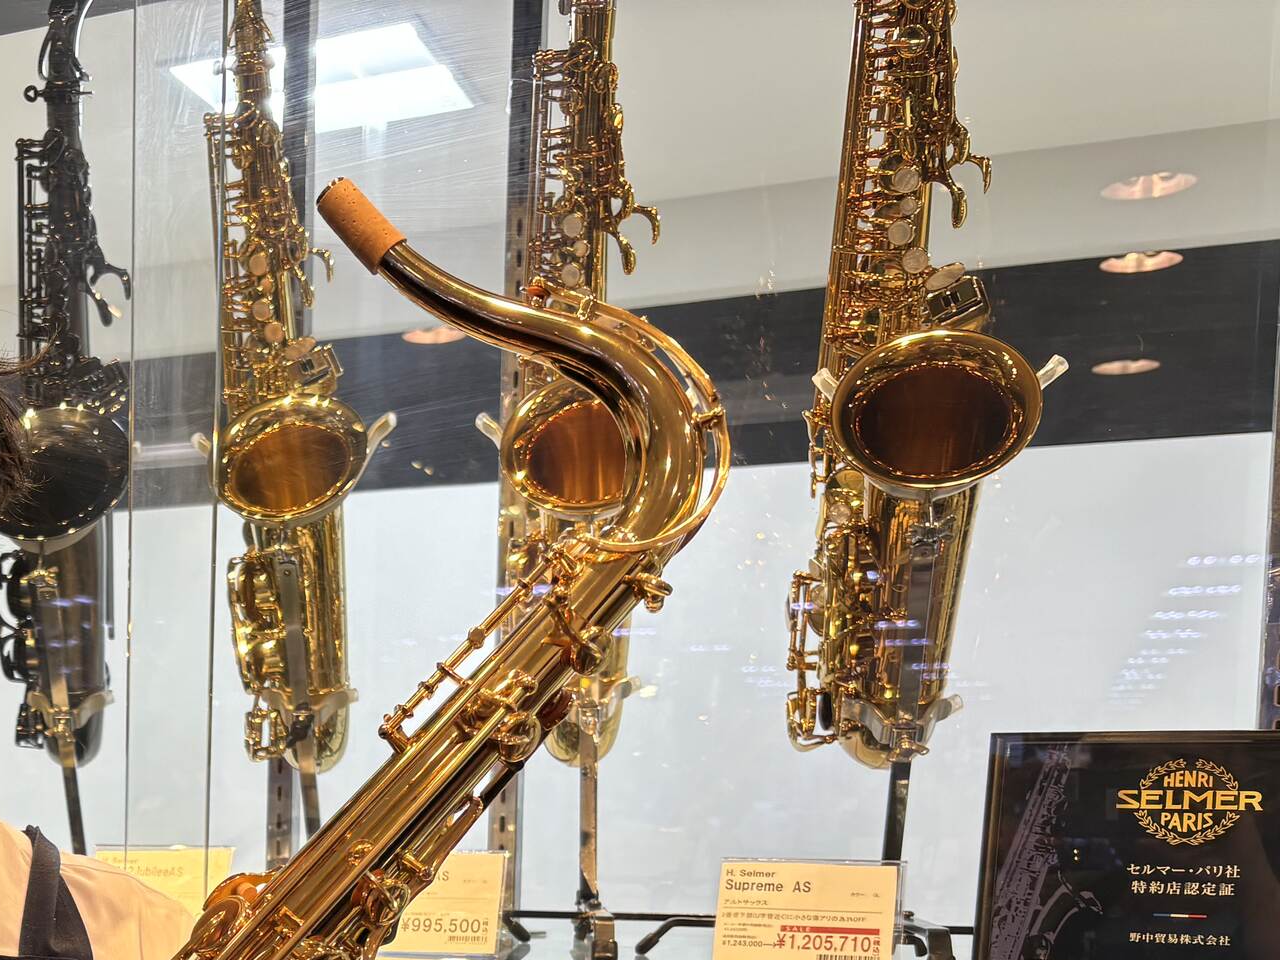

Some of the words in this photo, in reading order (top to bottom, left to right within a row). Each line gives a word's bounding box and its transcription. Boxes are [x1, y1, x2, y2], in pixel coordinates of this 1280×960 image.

[1163, 770, 1213, 789] HENRI
[1116, 789, 1263, 812] SELMER
[1160, 812, 1214, 833] PARIS
[725, 869, 736, 877] H.
[739, 869, 776, 879] Selmer
[1126, 863, 1241, 880] セルマー・パリ社
[725, 878, 784, 893] Supreme
[792, 881, 812, 893] AS
[1131, 881, 1236, 897] 特約店認定証
[401, 918, 480, 934] ¥995,500
[777, 933, 871, 953] ¥1,205,710
[1128, 931, 1231, 947] 野中貿易株式会社
